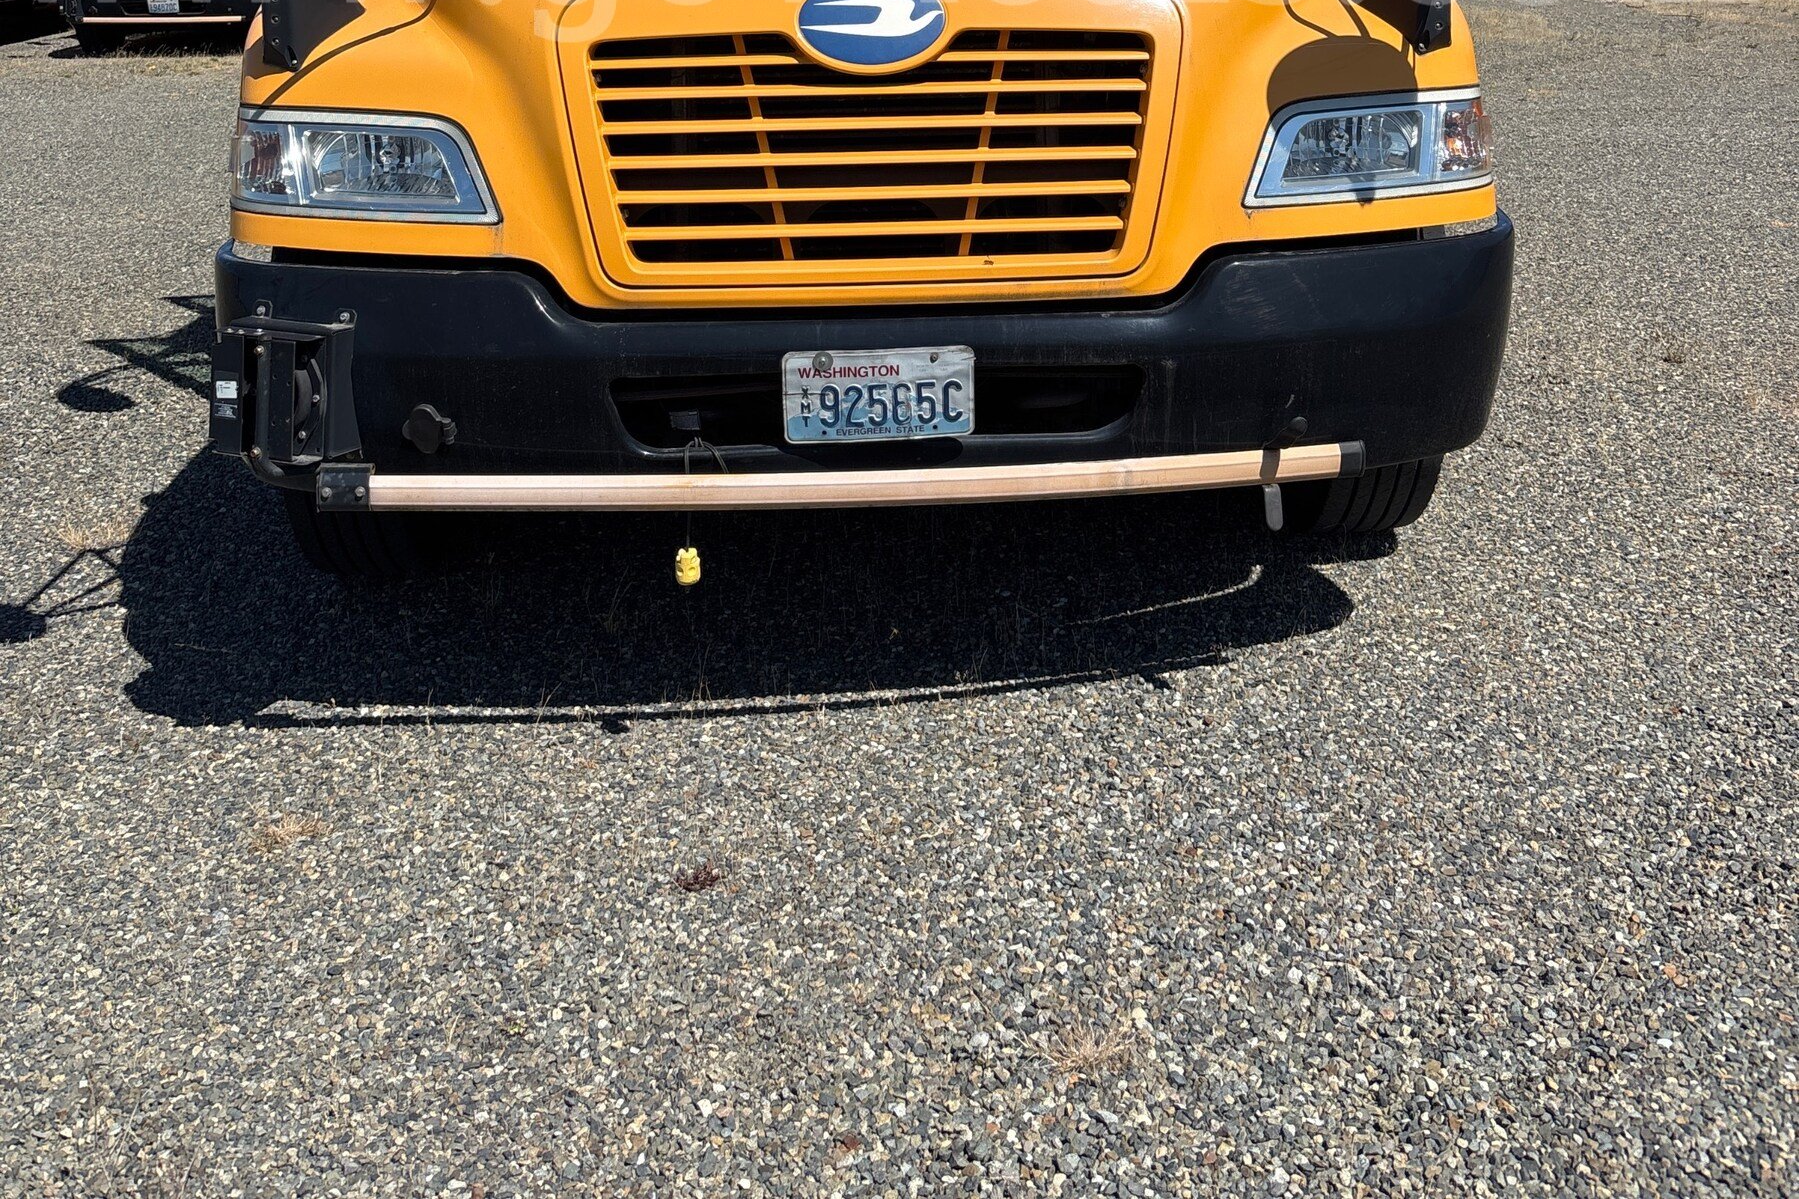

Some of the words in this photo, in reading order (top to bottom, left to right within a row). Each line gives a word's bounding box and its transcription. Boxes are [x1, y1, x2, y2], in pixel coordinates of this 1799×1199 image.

[798, 364, 900, 379] WASHINGTON
[836, 426, 892, 436] EVERGREEN
[896, 424, 925, 434] STATE
